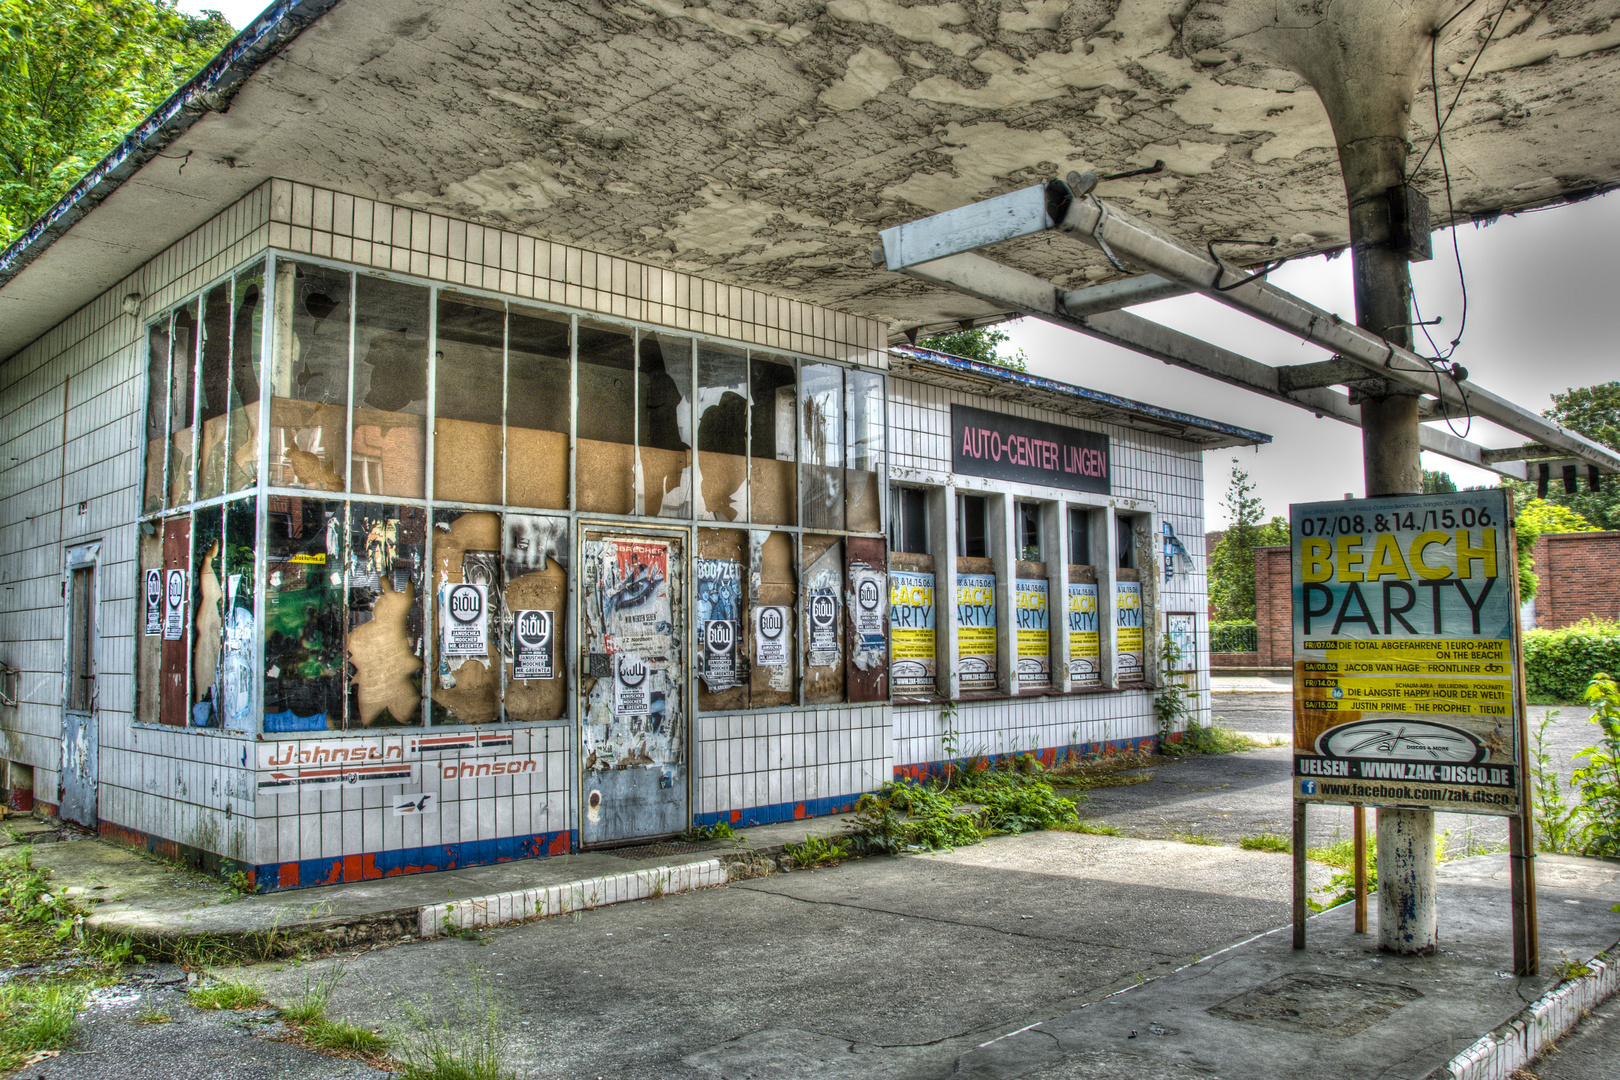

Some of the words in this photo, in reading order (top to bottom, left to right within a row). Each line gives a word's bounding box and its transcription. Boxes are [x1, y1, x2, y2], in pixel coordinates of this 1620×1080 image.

[962, 426, 1059, 471] AUTO-CENTER
[1063, 444, 1107, 478] LINGEN
[1301, 528, 1498, 583] BEACH
[890, 586, 932, 607] EACH
[957, 587, 993, 606] EACH
[1016, 592, 1046, 610] EACH
[1069, 595, 1096, 613] EACH
[1117, 593, 1140, 610] ACH
[1303, 577, 1497, 635] PARTY
[891, 605, 931, 628] ARTY
[957, 605, 991, 626] ARTY
[1016, 609, 1045, 629] ARTY
[1069, 612, 1095, 631] ARTY
[520, 619, 547, 636] GLOW
[1339, 641, 1352, 650] DIE
[1354, 641, 1379, 650] TOTAL
[1381, 641, 1442, 650] ABGEFAHRENE
[1436, 651, 1451, 659] ON
[1453, 651, 1468, 659] THE
[1471, 651, 1503, 660] BEACH!
[1344, 663, 1374, 672] JACOB
[1375, 664, 1393, 672] VAN
[1395, 664, 1420, 672] HAGE
[1428, 664, 1481, 673] FRONTLINER
[1347, 688, 1361, 696] DIE
[1404, 689, 1431, 698] HAPPY
[1433, 690, 1458, 698] HOUR
[1461, 690, 1478, 699] DER
[1480, 691, 1505, 700] WELT!
[1351, 702, 1378, 710] JUSTIN
[1381, 702, 1406, 711] PRIME
[1415, 703, 1430, 712] THE
[1432, 704, 1471, 713] PROPHET
[1479, 705, 1505, 714] TIEUM
[268, 744, 402, 767] Johnson
[442, 759, 537, 780] ohnson
[1300, 759, 1349, 776] UELSEN
[1360, 761, 1510, 785] WWW.ZAK-DISCO.DE
[1321, 783, 1510, 805] www.facebook.com/zak.disco
